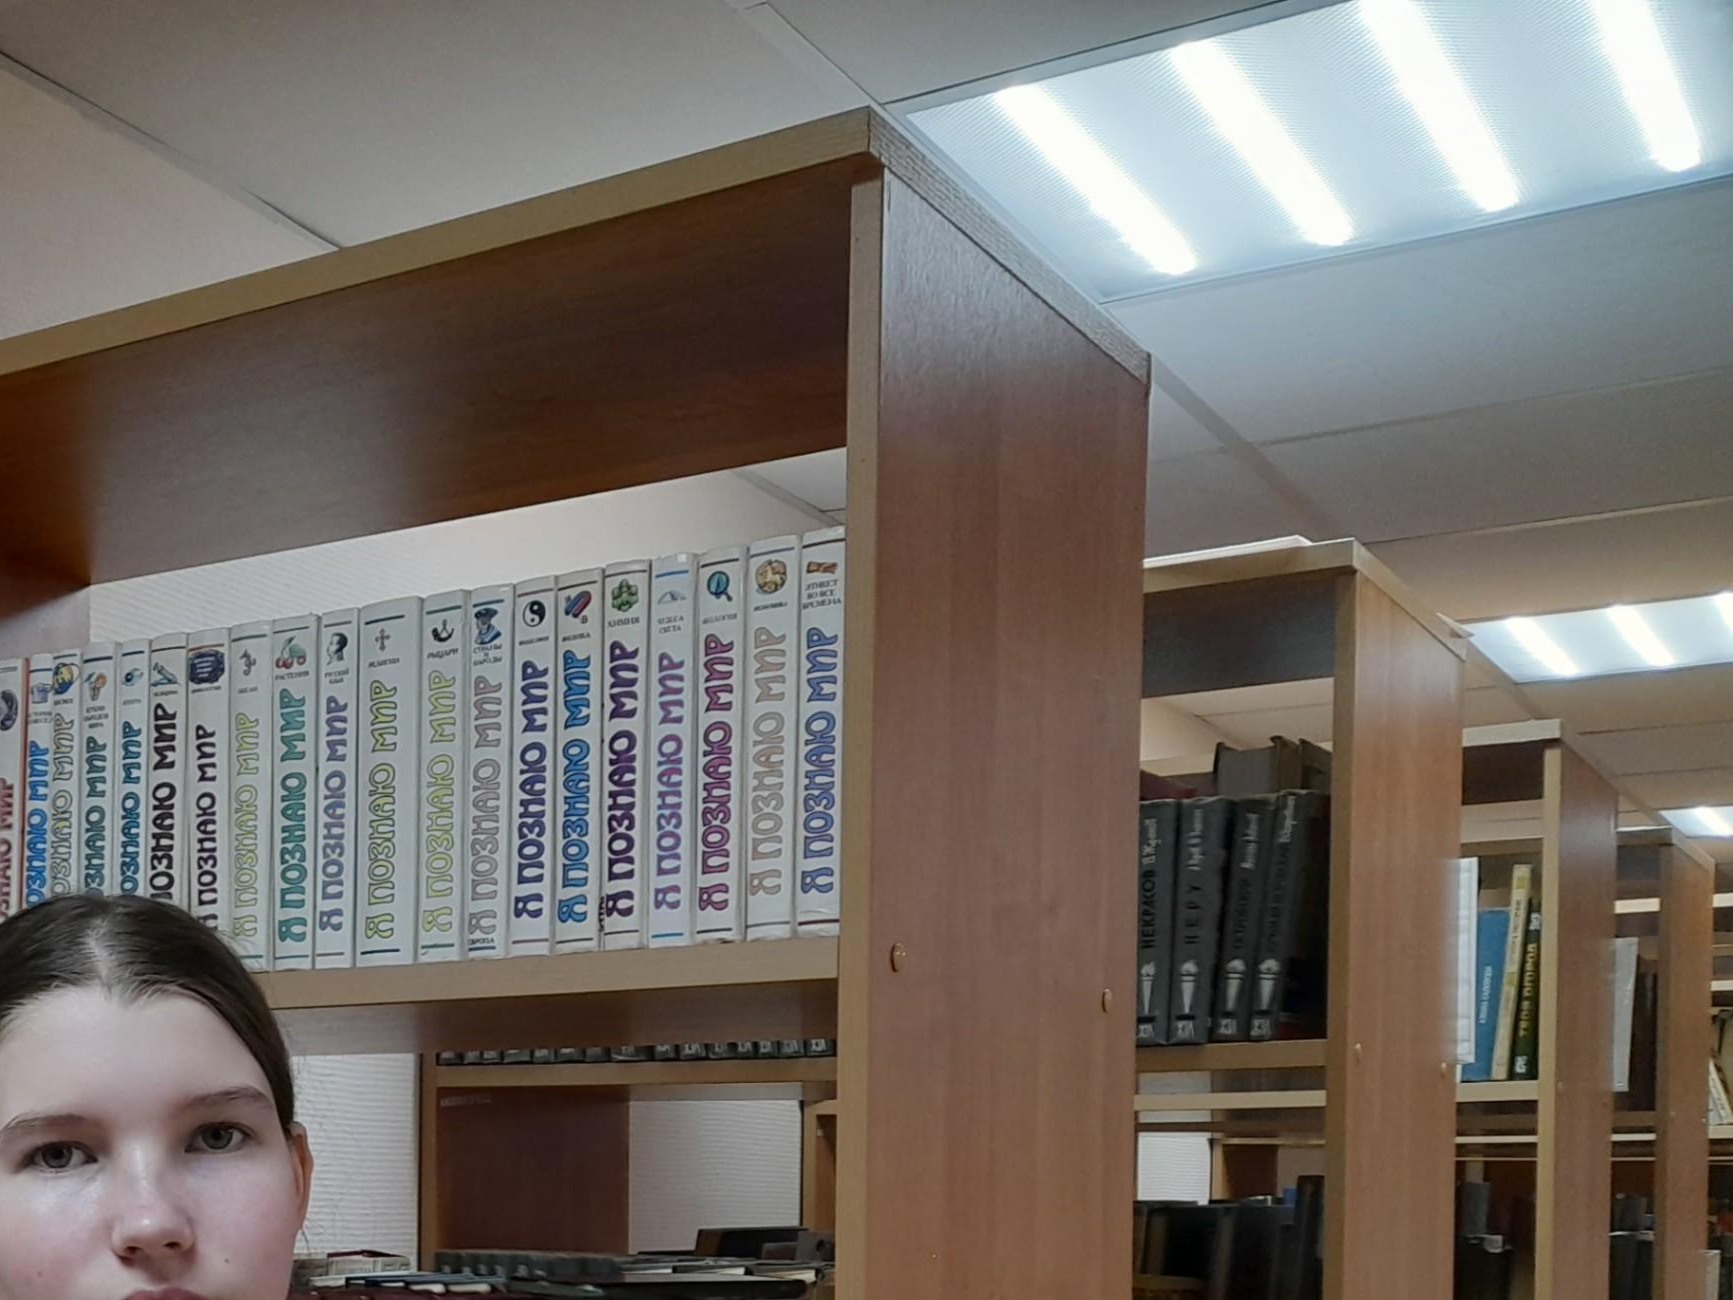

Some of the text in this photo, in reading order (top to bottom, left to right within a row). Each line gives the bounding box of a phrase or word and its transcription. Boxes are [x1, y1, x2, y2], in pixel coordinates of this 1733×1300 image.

[26, 808, 48, 907] ОЗНАЮ
[28, 740, 49, 801] МИР
[51, 713, 74, 897] ОЗНАЮ МИР
[86, 736, 107, 798] МИР
[120, 720, 142, 896] ОЗНАЮ МИР
[153, 703, 177, 771] МИР
[196, 724, 217, 782] МИР
[196, 792, 218, 906] ПОЗНАЮ
[232, 712, 259, 937] Я ПОЗНАЮ МИР
[278, 688, 307, 942] Я ПОЗНАЮ МИР
[319, 695, 348, 932] Я ПОЗНАЮ МИР
[365, 680, 397, 939] Я ПОЗНАЮ МИР
[422, 670, 456, 932] Я ПОЗНАЮ МИР
[469, 675, 502, 935] Я ПОЗНАЮ МИР
[514, 660, 548, 920] Я ПОЗНАЮ МИР
[558, 650, 591, 923] Я ПОЗНАЮ МИР
[605, 640, 639, 918] Я ПОЗНАЮ МИР
[654, 651, 685, 911] Я ПОЗНАЮ МИР
[699, 633, 734, 911] Я ПОЗНАЮ МИР
[749, 626, 787, 896] Я ПОЗНАЮ МИР
[800, 626, 838, 894] Я ПОЗНАЮ МИР
